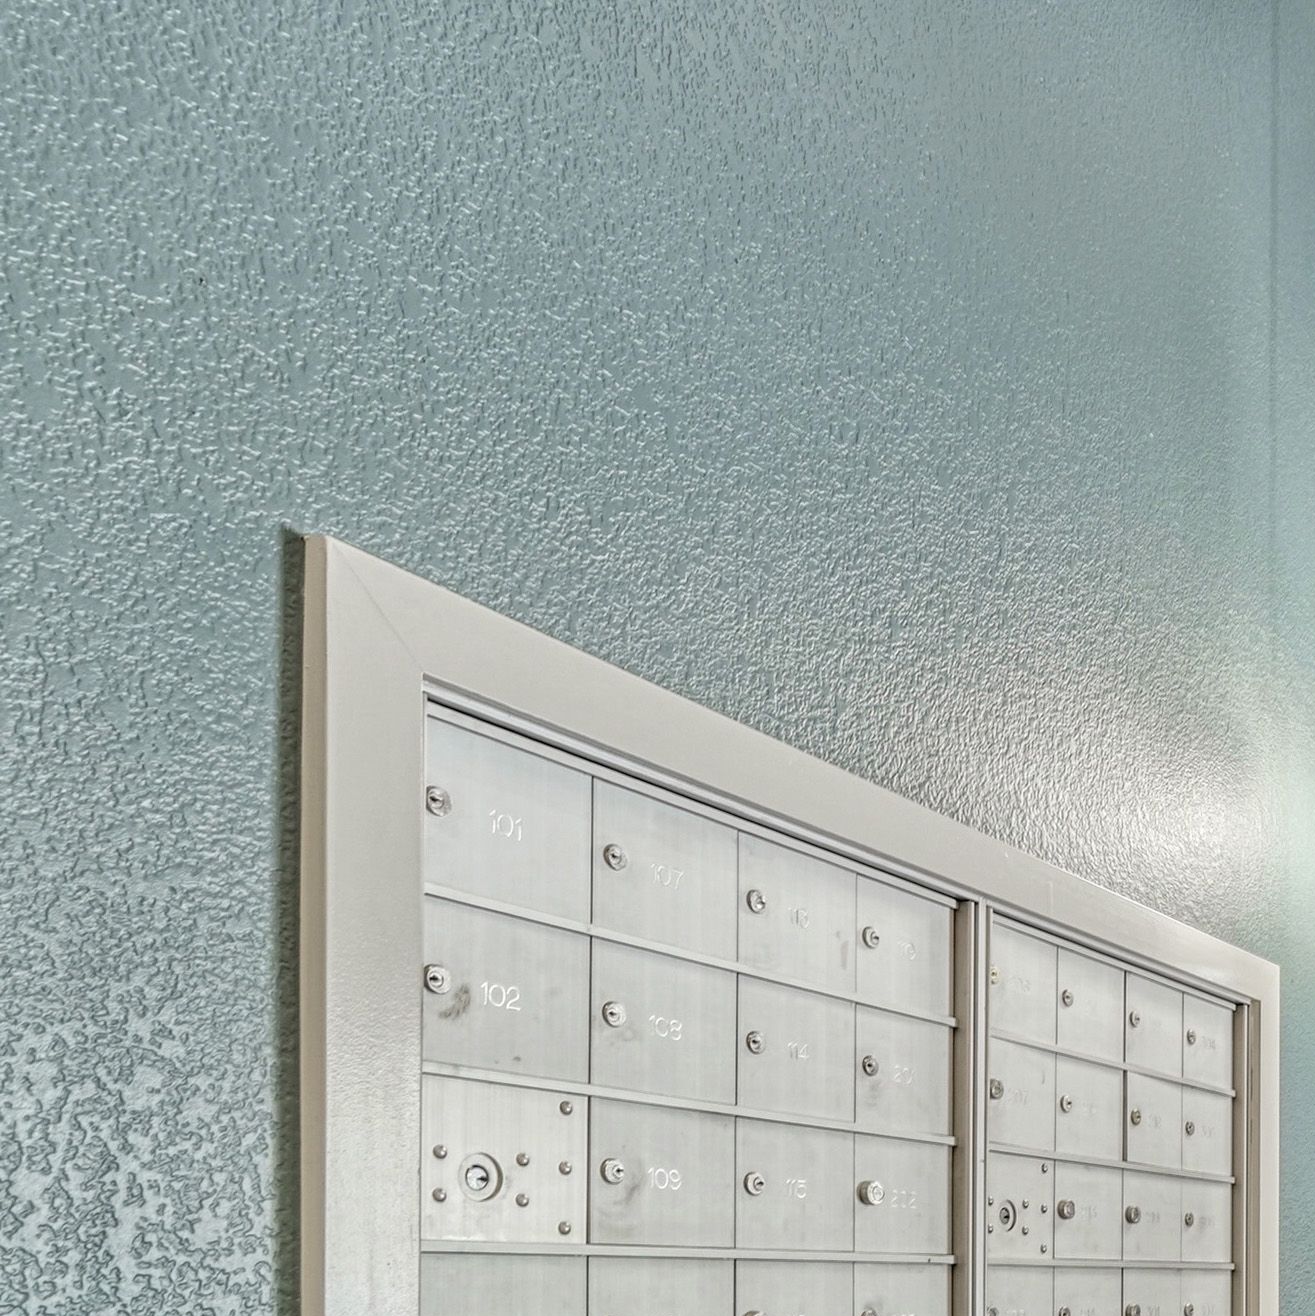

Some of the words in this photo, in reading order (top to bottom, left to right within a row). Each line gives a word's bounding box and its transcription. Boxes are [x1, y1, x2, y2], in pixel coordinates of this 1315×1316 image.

[489, 807, 523, 842] 101
[651, 863, 685, 891] 107
[479, 981, 522, 1012] 102
[649, 1015, 683, 1041] 108
[648, 1166, 683, 1191] 109
